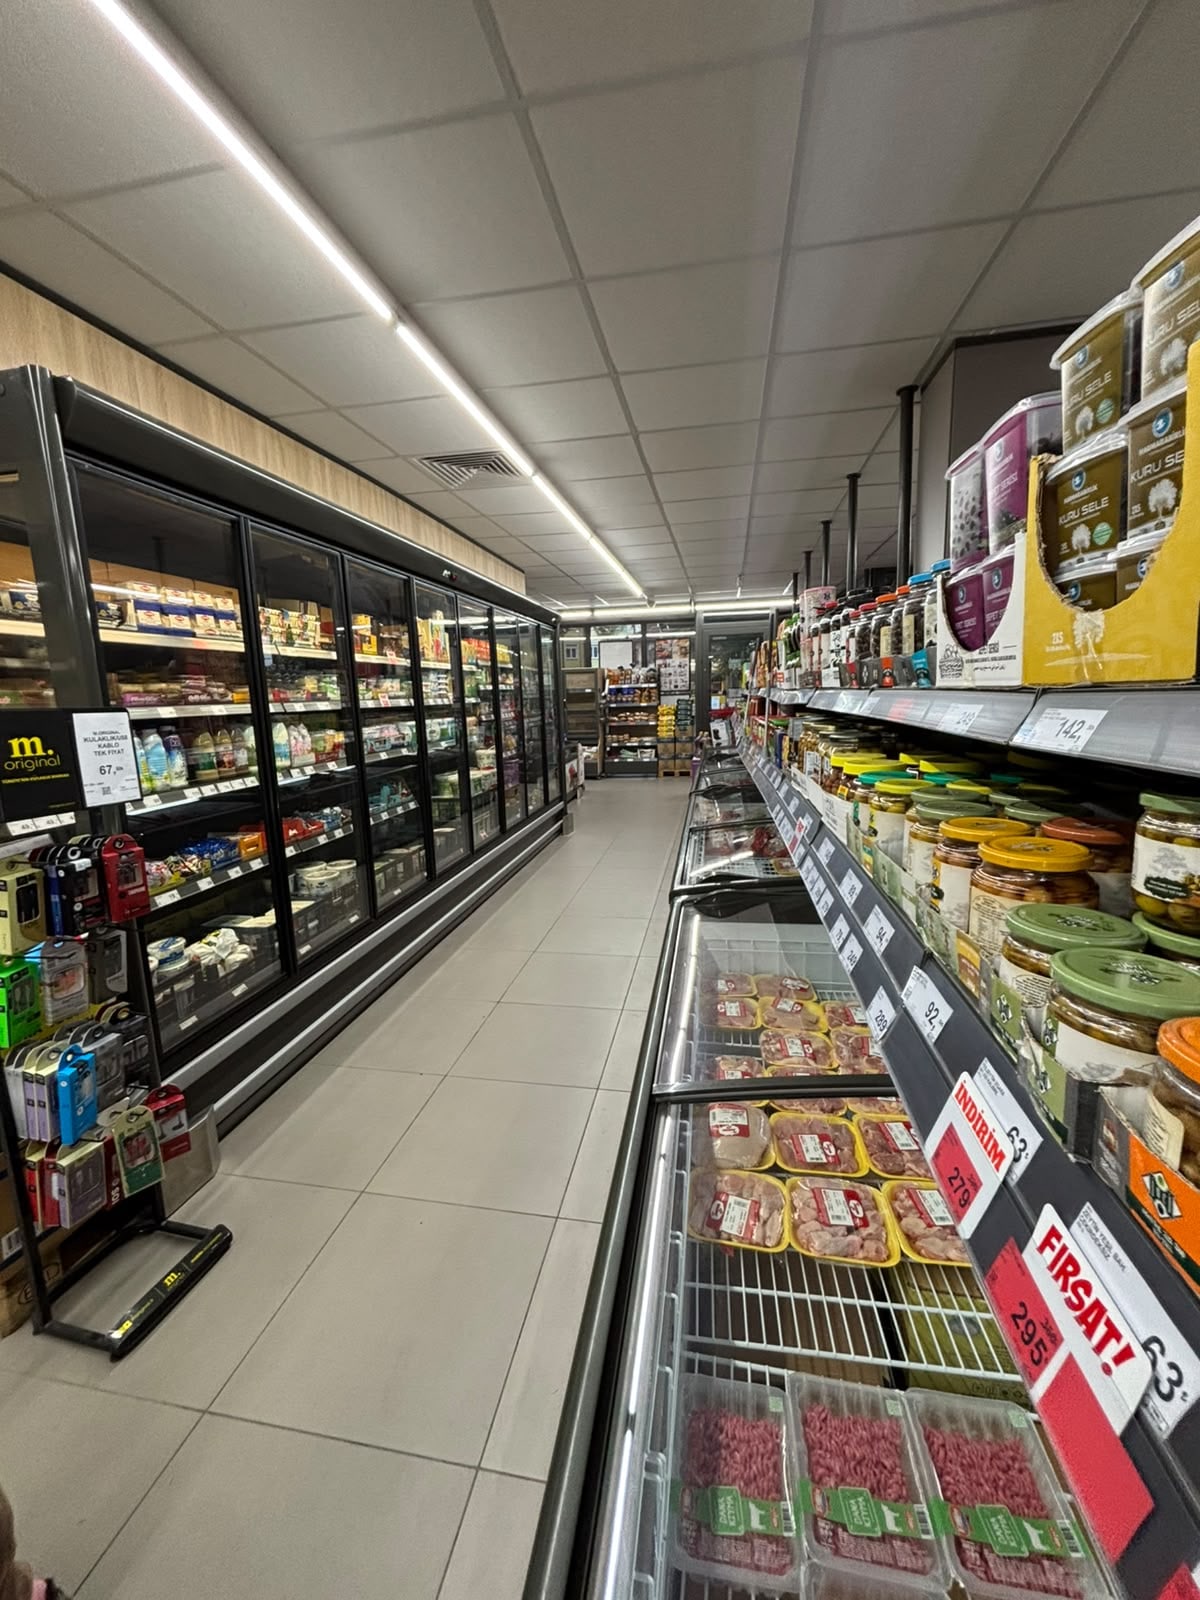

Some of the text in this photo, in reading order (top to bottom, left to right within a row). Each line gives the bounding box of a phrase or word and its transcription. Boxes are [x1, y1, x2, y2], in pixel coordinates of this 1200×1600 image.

[1130, 459, 1162, 483] KURU
[1058, 495, 1110, 526] KURU SELE
[4, 755, 61, 771] original
[954, 1079, 1006, 1173] İNDİRİM
[947, 1167, 972, 1209] 279
[1035, 1224, 1136, 1377] FIRSAT!
[1010, 1301, 1049, 1367] 295
